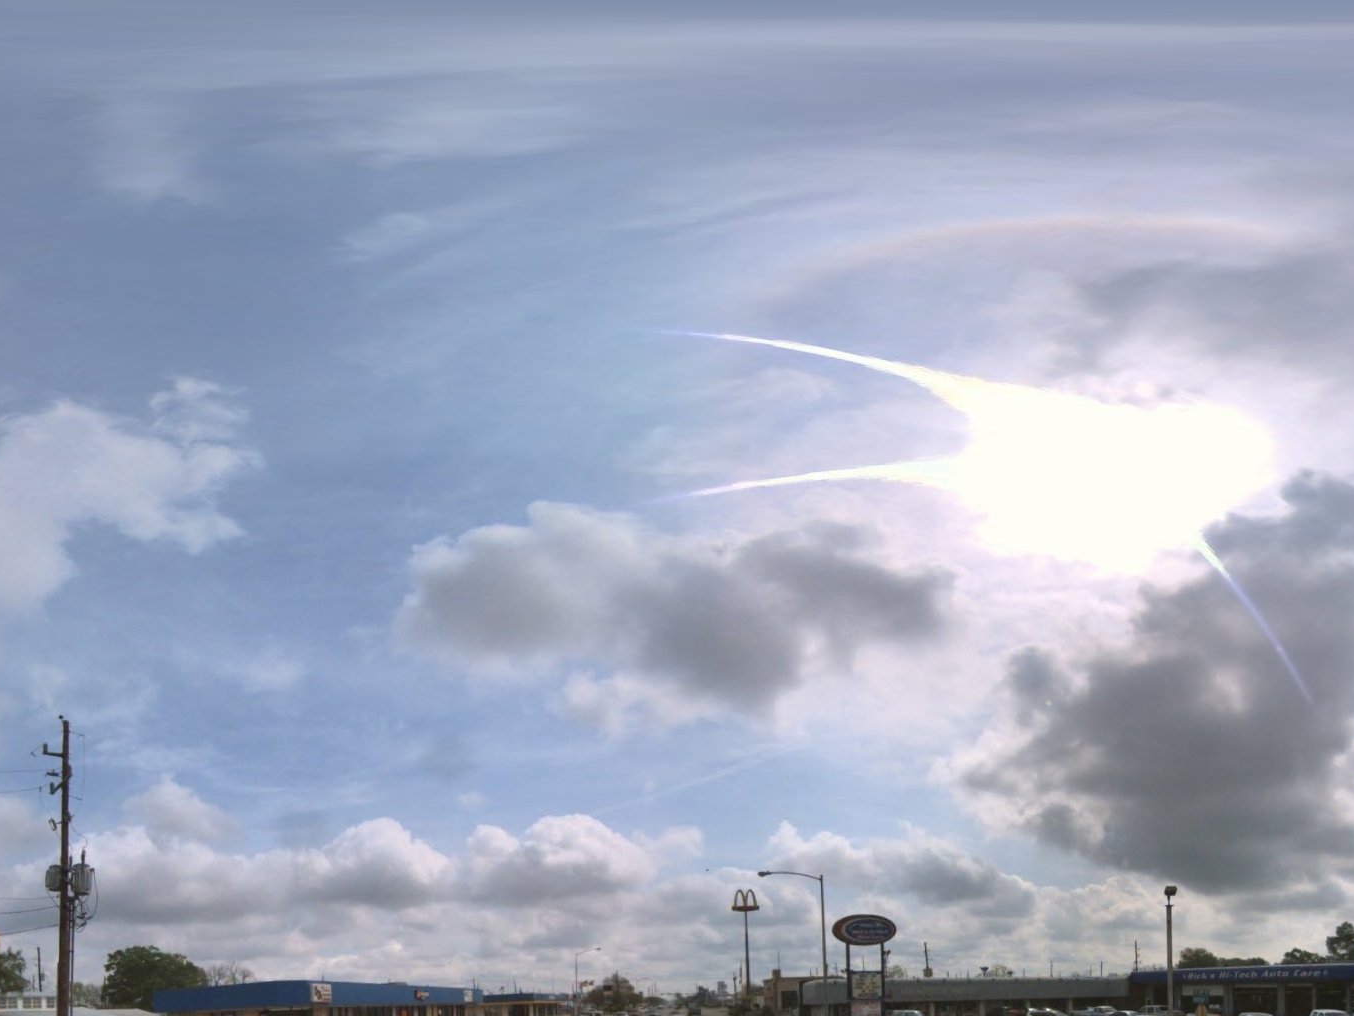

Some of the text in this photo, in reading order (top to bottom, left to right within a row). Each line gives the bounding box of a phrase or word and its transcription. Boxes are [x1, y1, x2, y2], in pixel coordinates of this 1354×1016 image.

[1187, 969, 1321, 980] Rick's Hi-Tech Auto Care
